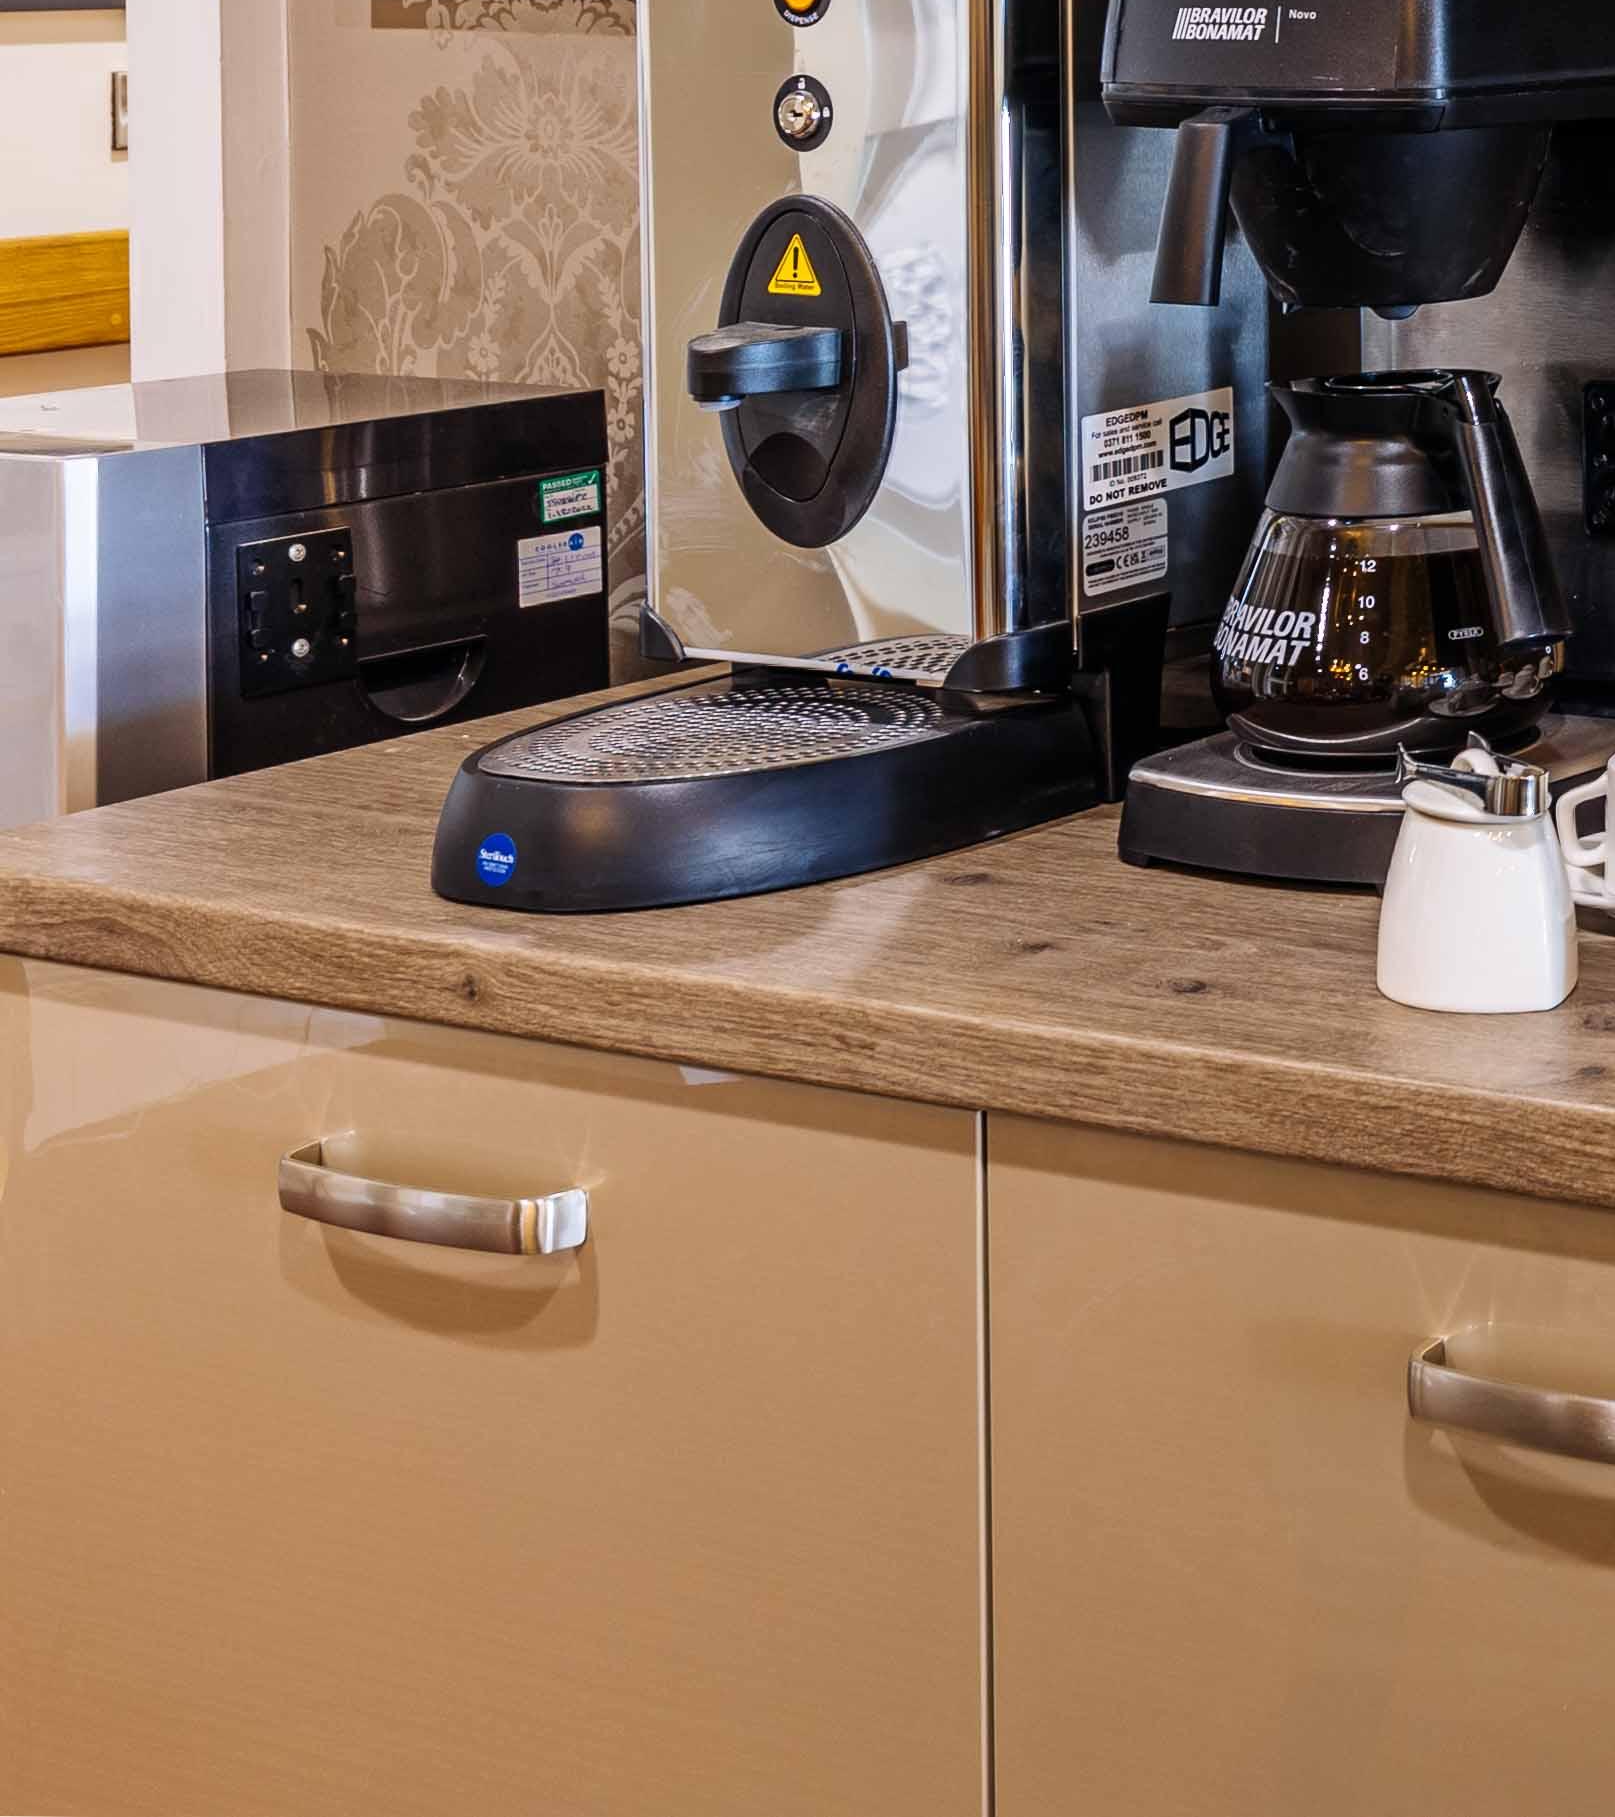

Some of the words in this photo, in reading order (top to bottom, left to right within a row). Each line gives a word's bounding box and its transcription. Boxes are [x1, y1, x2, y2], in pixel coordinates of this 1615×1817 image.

[1189, 7, 1268, 25] BRAVILOR
[1288, 9, 1317, 20] Novo
[1185, 24, 1266, 41] BONAMAT
[1105, 409, 1148, 427] EDGEDPM
[1169, 407, 1231, 473] EDGE
[1089, 493, 1103, 505] DO
[1106, 487, 1126, 502] NOT
[1128, 477, 1168, 496] REMOVE
[1084, 526, 1130, 550] 239458
[1358, 559, 1377, 574] 12
[1358, 595, 1375, 609] 10
[1359, 631, 1370, 645] 8
[1358, 667, 1369, 681] 6
